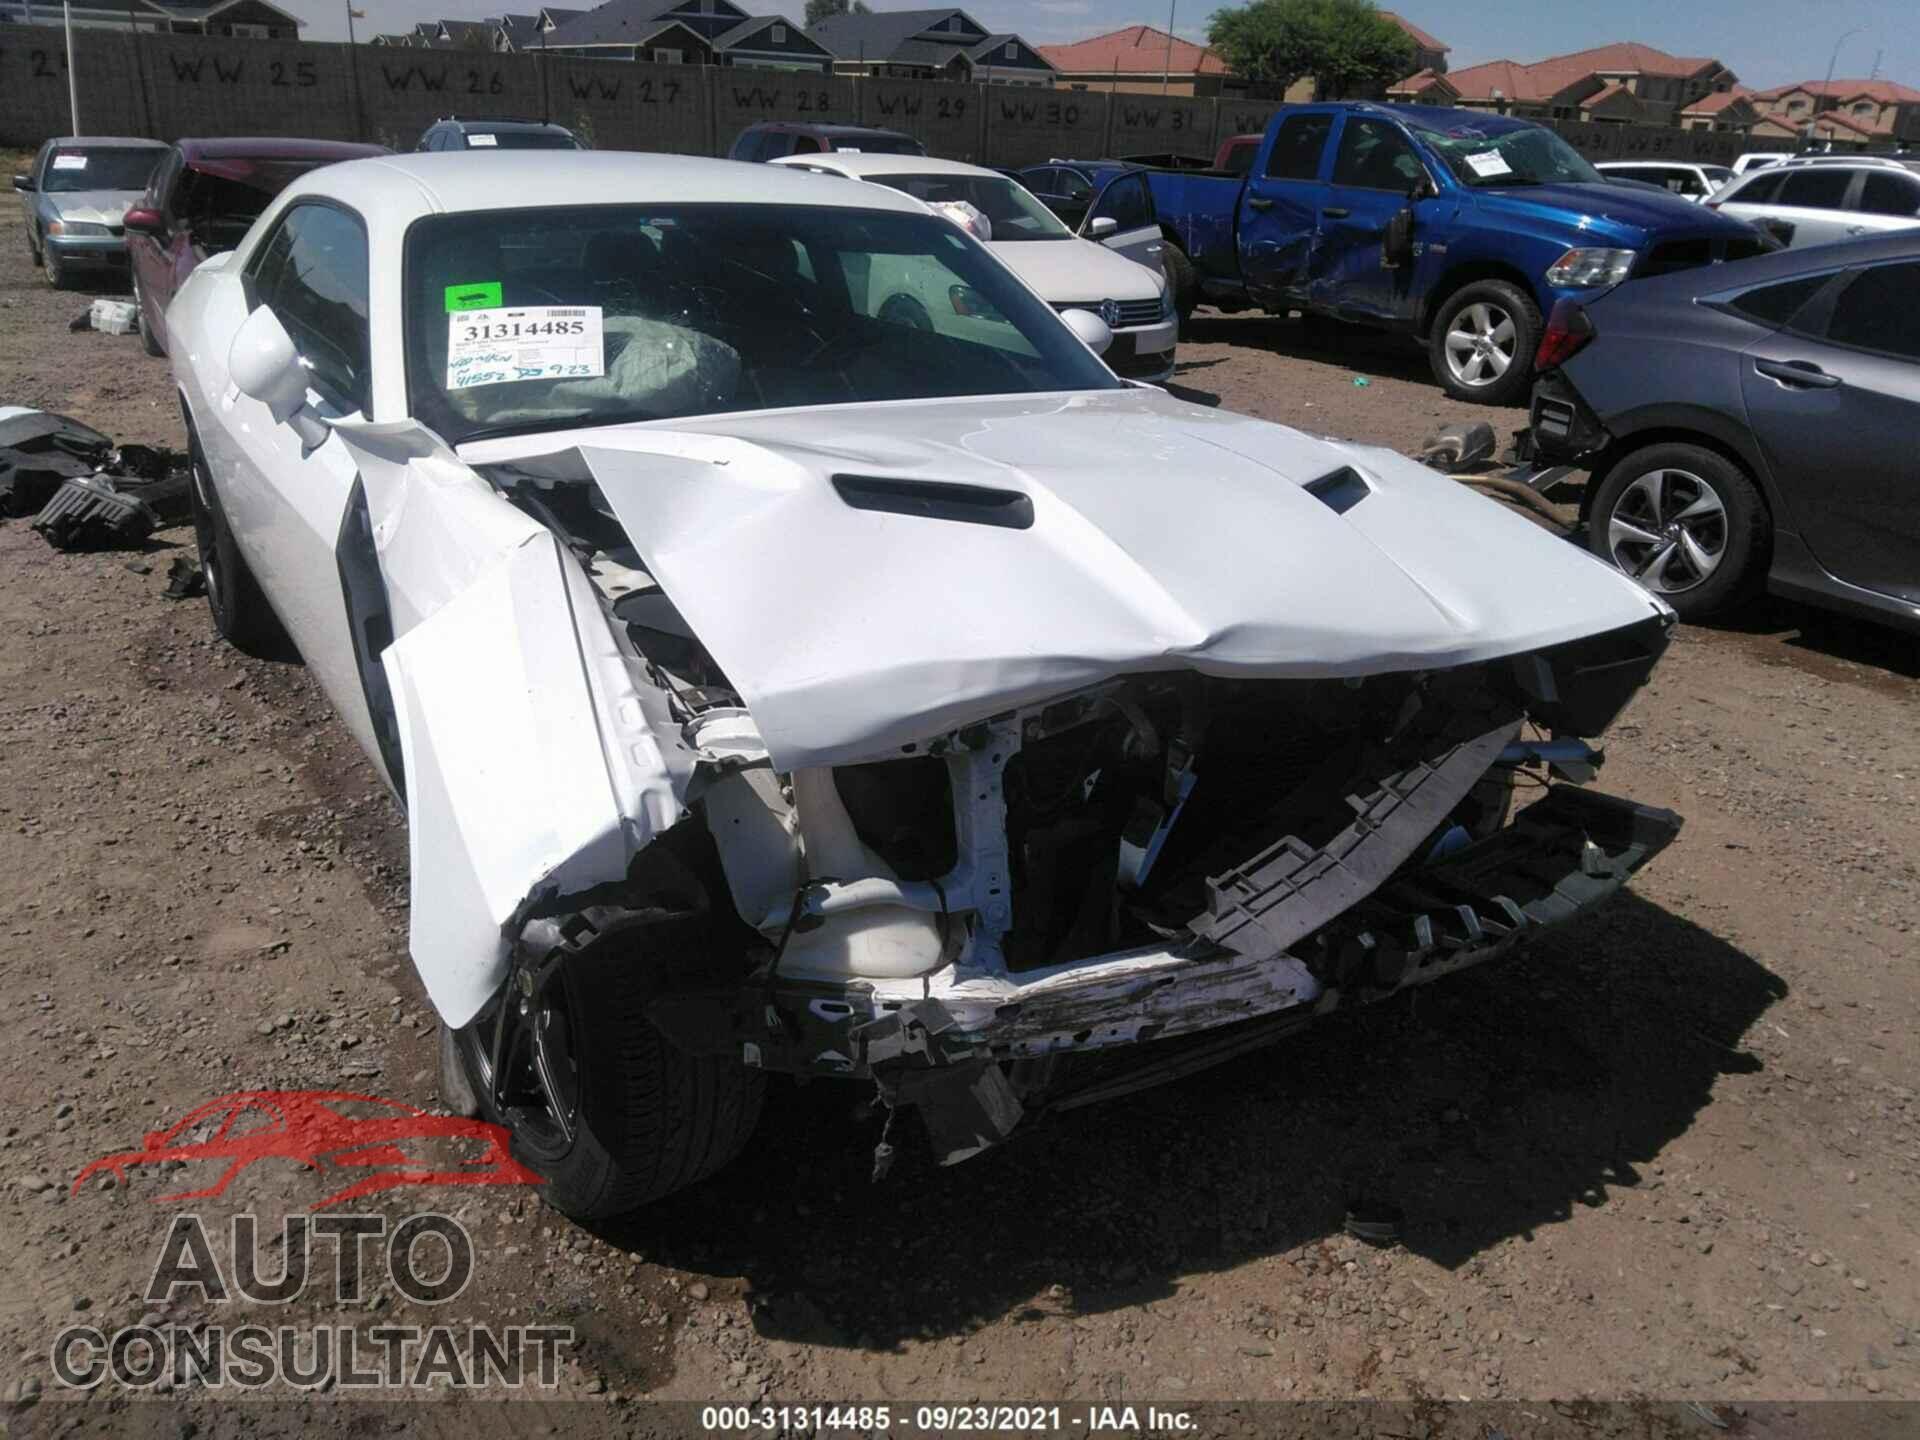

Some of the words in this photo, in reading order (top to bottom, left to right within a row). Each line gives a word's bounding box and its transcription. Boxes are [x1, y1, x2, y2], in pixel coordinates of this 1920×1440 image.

[270, 61, 318, 87] 25
[468, 71, 504, 95] 26
[640, 80, 680, 104] 27
[798, 90, 830, 113] 28
[938, 97, 967, 119] 29
[1047, 104, 1080, 125] 30
[1172, 108, 1193, 130] 31
[464, 321, 585, 342] 31314485
